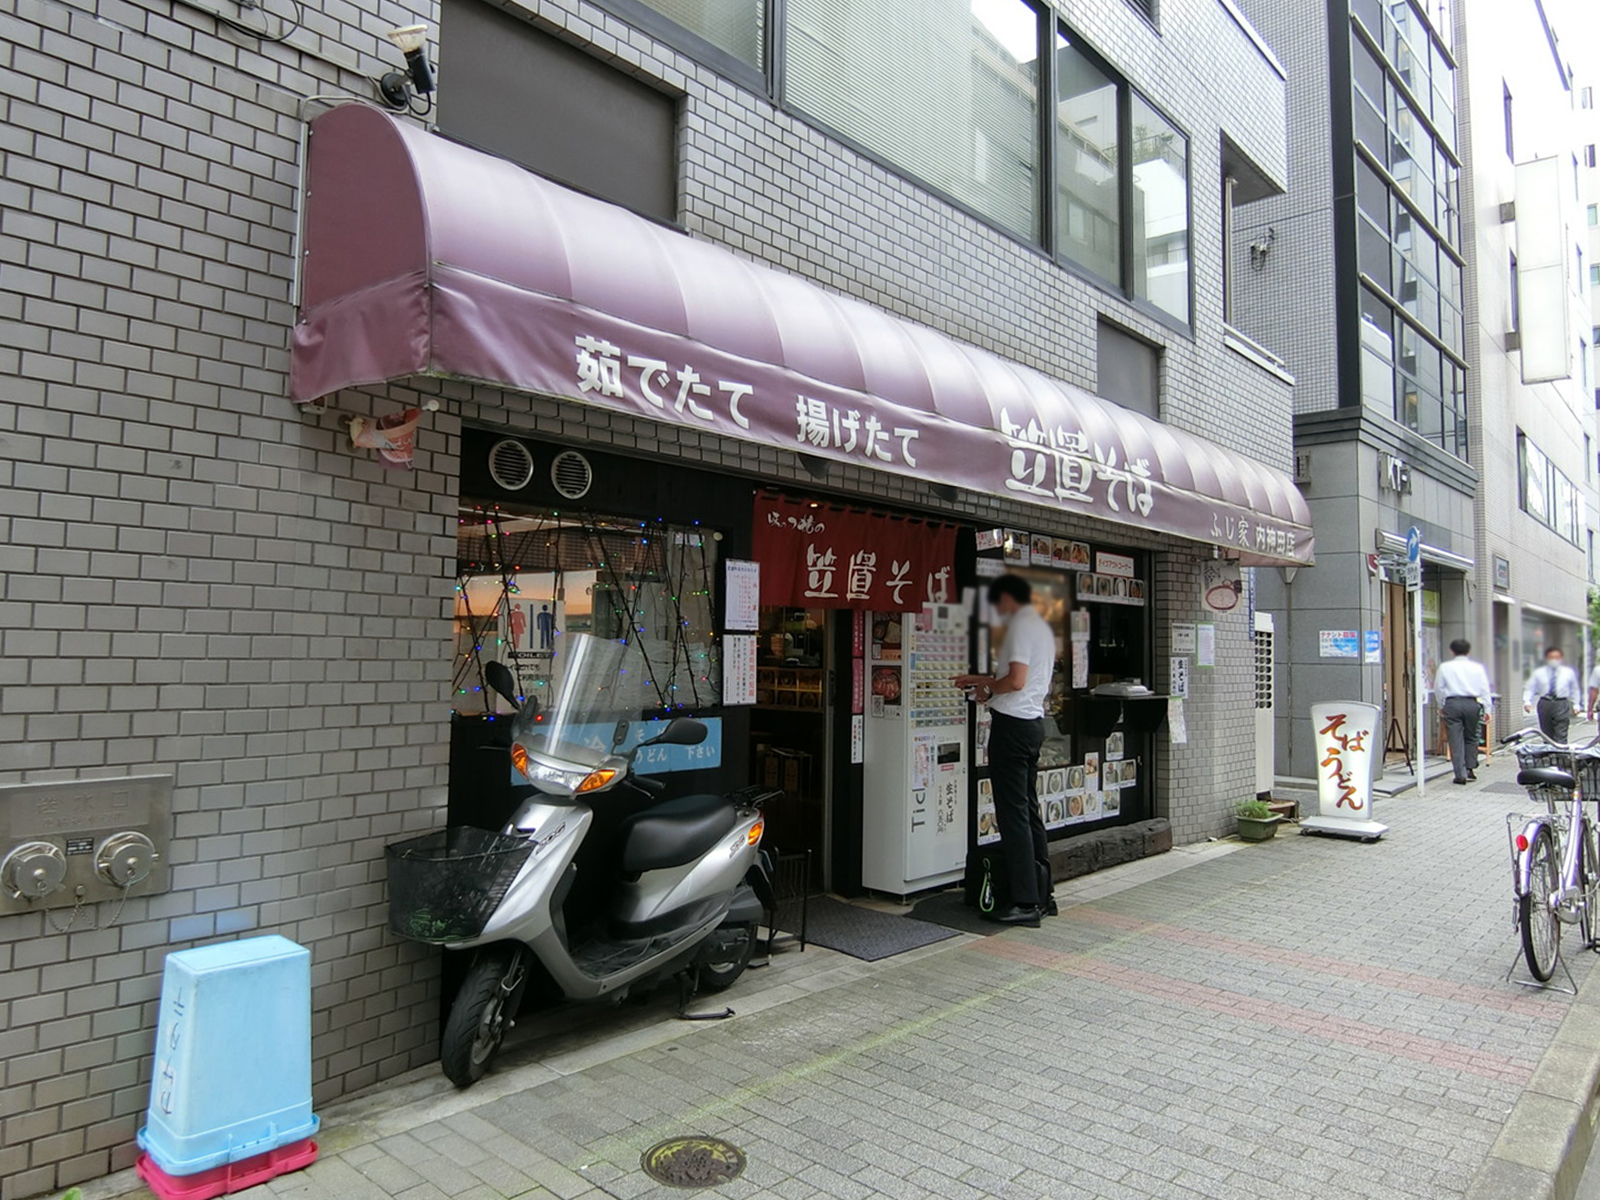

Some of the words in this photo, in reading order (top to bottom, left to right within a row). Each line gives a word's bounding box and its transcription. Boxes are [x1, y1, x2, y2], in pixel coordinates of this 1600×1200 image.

[575, 335, 753, 430] 茹でたて
[797, 396, 919, 467] 揚げたて
[999, 407, 1153, 517] 笠置そば
[1210, 512, 1249, 547] ふじ家
[1256, 523, 1295, 557] 内神田店
[804, 543, 951, 604] 笠置そば
[685, 745, 716, 760] 下さい
[1319, 714, 1369, 752] そば
[1321, 747, 1363, 811] うどん
